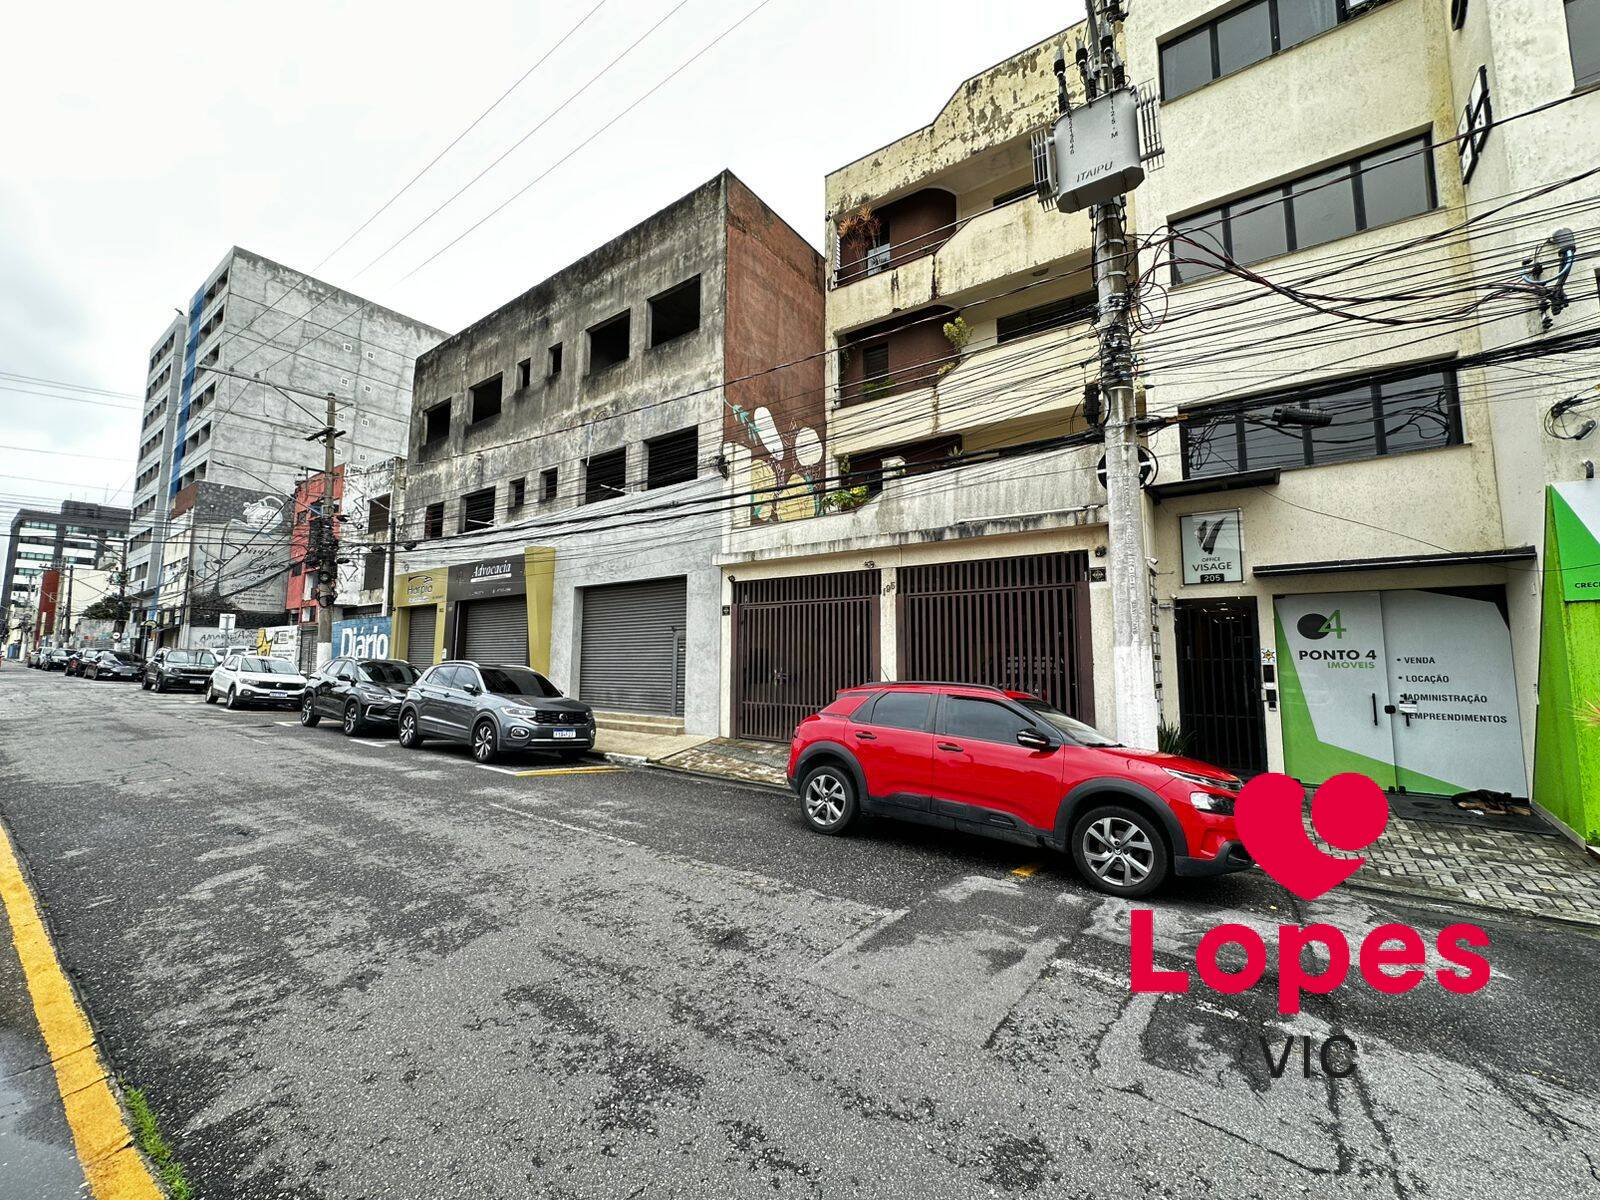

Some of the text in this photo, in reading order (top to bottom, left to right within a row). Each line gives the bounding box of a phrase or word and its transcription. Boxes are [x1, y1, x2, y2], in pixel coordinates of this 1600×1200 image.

[1077, 161, 1114, 183] ITAIPU
[471, 560, 512, 578] Advocacia
[1192, 561, 1233, 572] VISAGE
[1203, 574, 1221, 582] 205
[883, 581, 896, 597] 195
[340, 625, 389, 660] Diário
[1298, 649, 1377, 661] PONTO 4
[1403, 656, 1436, 664] VENDA
[1405, 673, 1450, 685] LOCAÇÃO
[1407, 692, 1488, 704] ADMINISTRAÇÃO
[1408, 712, 1508, 723] EMPREENDIMENTOS
